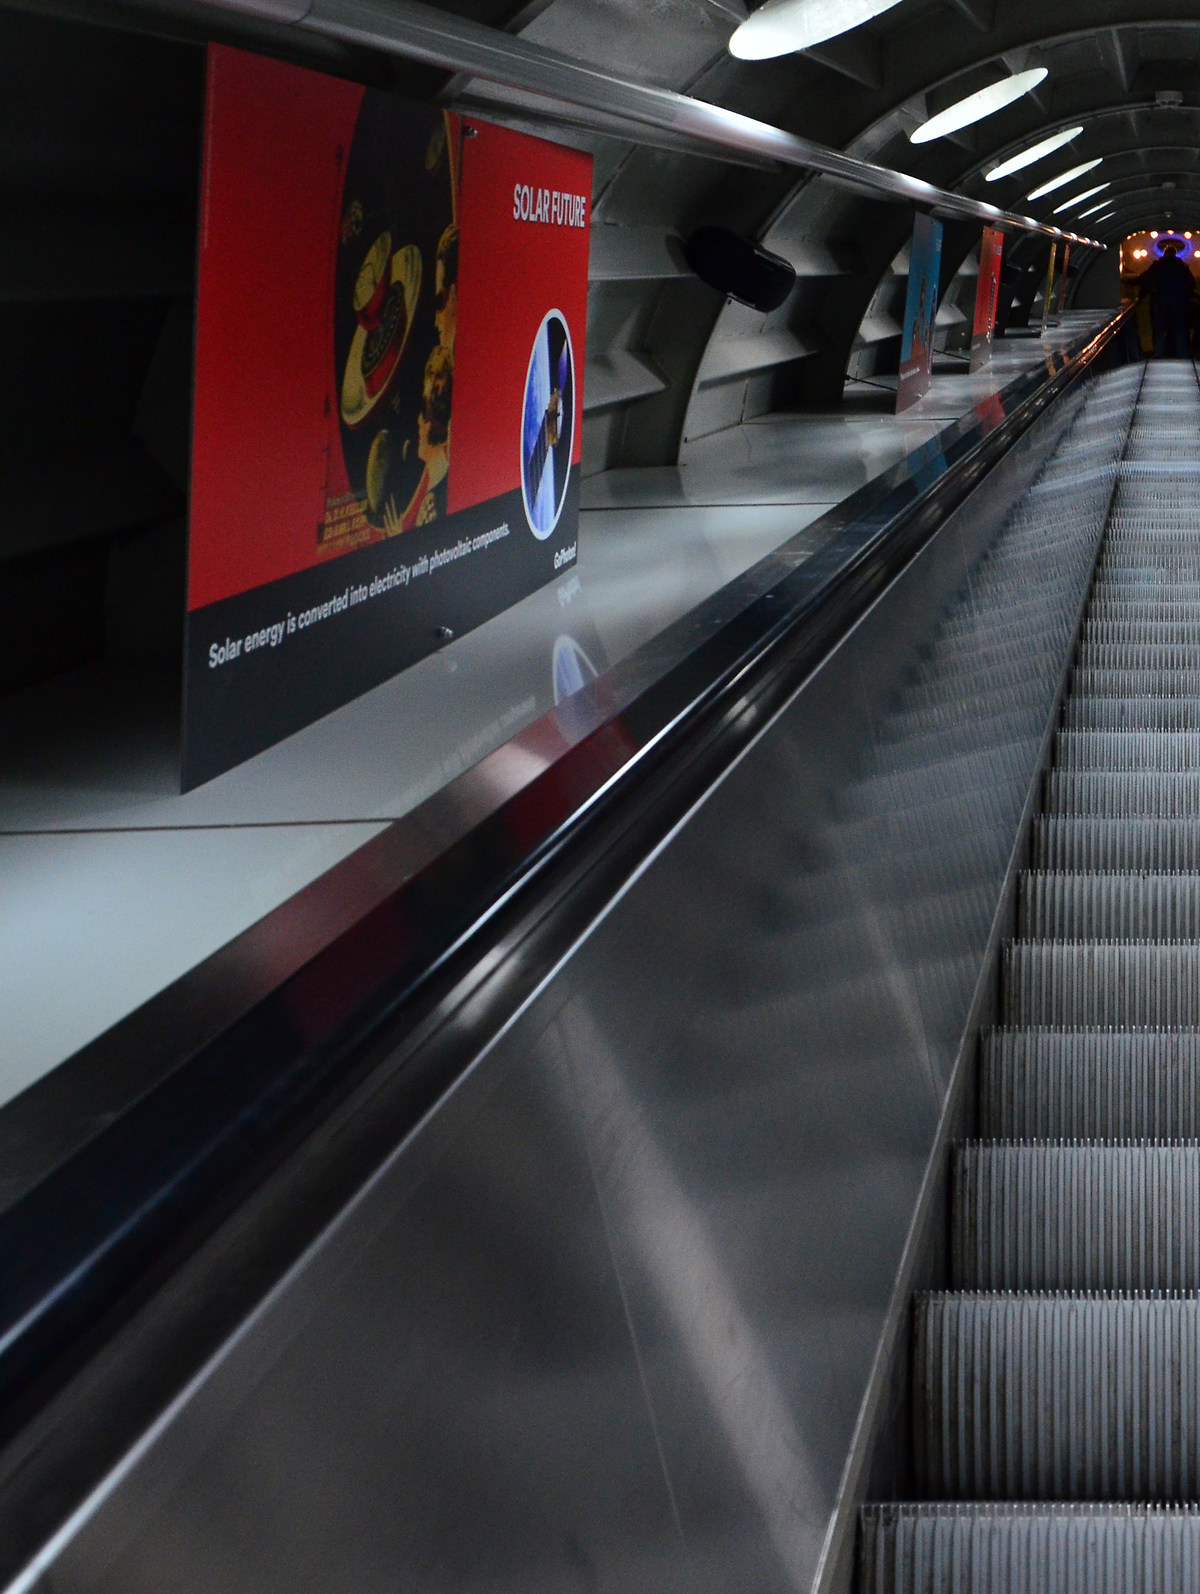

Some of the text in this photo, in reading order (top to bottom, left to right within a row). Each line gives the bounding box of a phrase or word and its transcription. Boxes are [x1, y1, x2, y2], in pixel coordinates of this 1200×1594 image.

[513, 183, 586, 228] SOLAR FUTURE
[208, 637, 242, 669] Solar
[244, 619, 285, 647] energy
[286, 612, 297, 635] is
[298, 587, 349, 630] converted
[349, 585, 369, 607] into
[369, 563, 412, 598] electricity
[412, 554, 429, 579] with
[429, 536, 472, 574] photovoltaic
